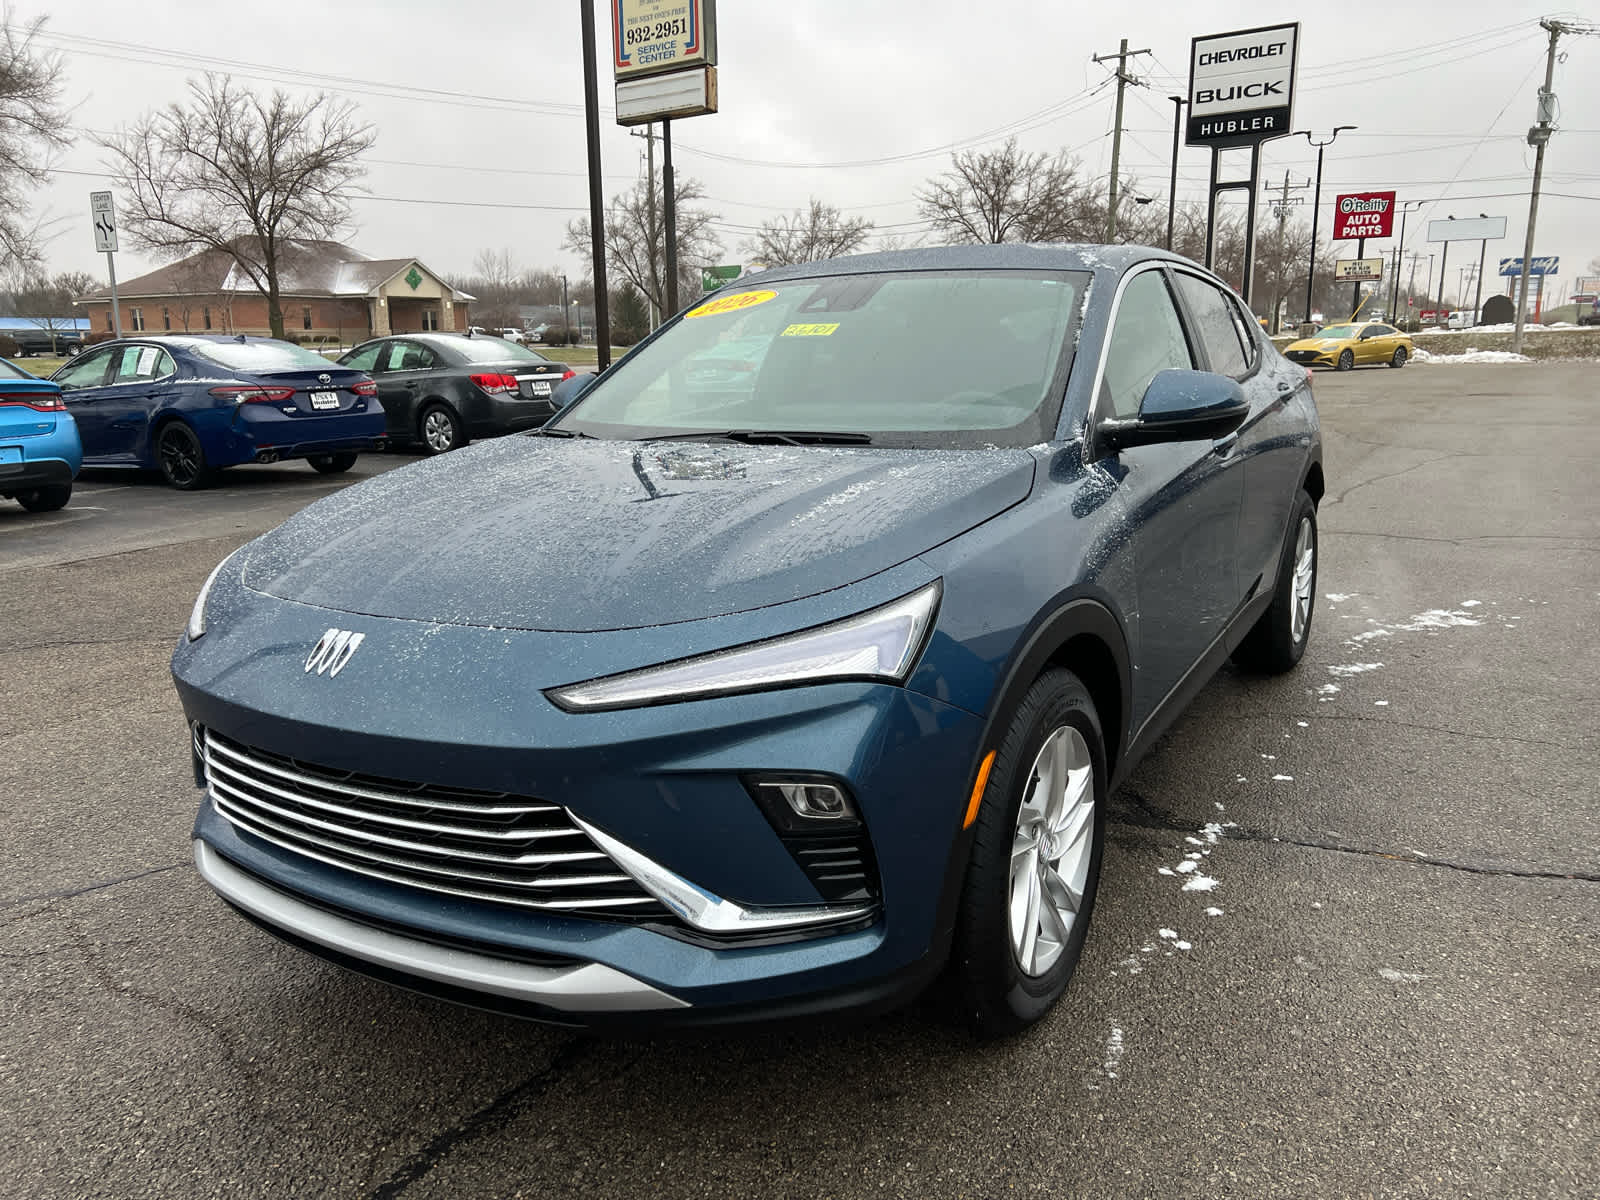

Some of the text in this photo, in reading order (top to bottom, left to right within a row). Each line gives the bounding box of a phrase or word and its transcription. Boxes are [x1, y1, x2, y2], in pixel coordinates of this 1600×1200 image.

[627, 17, 687, 45] 932-2951
[638, 40, 677, 55] SERVICE
[1199, 42, 1287, 66] CHEVROLET
[639, 50, 676, 64] CENTER
[1196, 80, 1284, 104] BUICK
[1201, 116, 1274, 135] HUBLER
[1341, 197, 1389, 213] O'Reilly
[1346, 214, 1381, 225] AUTO
[1342, 225, 1383, 237] PARTS
